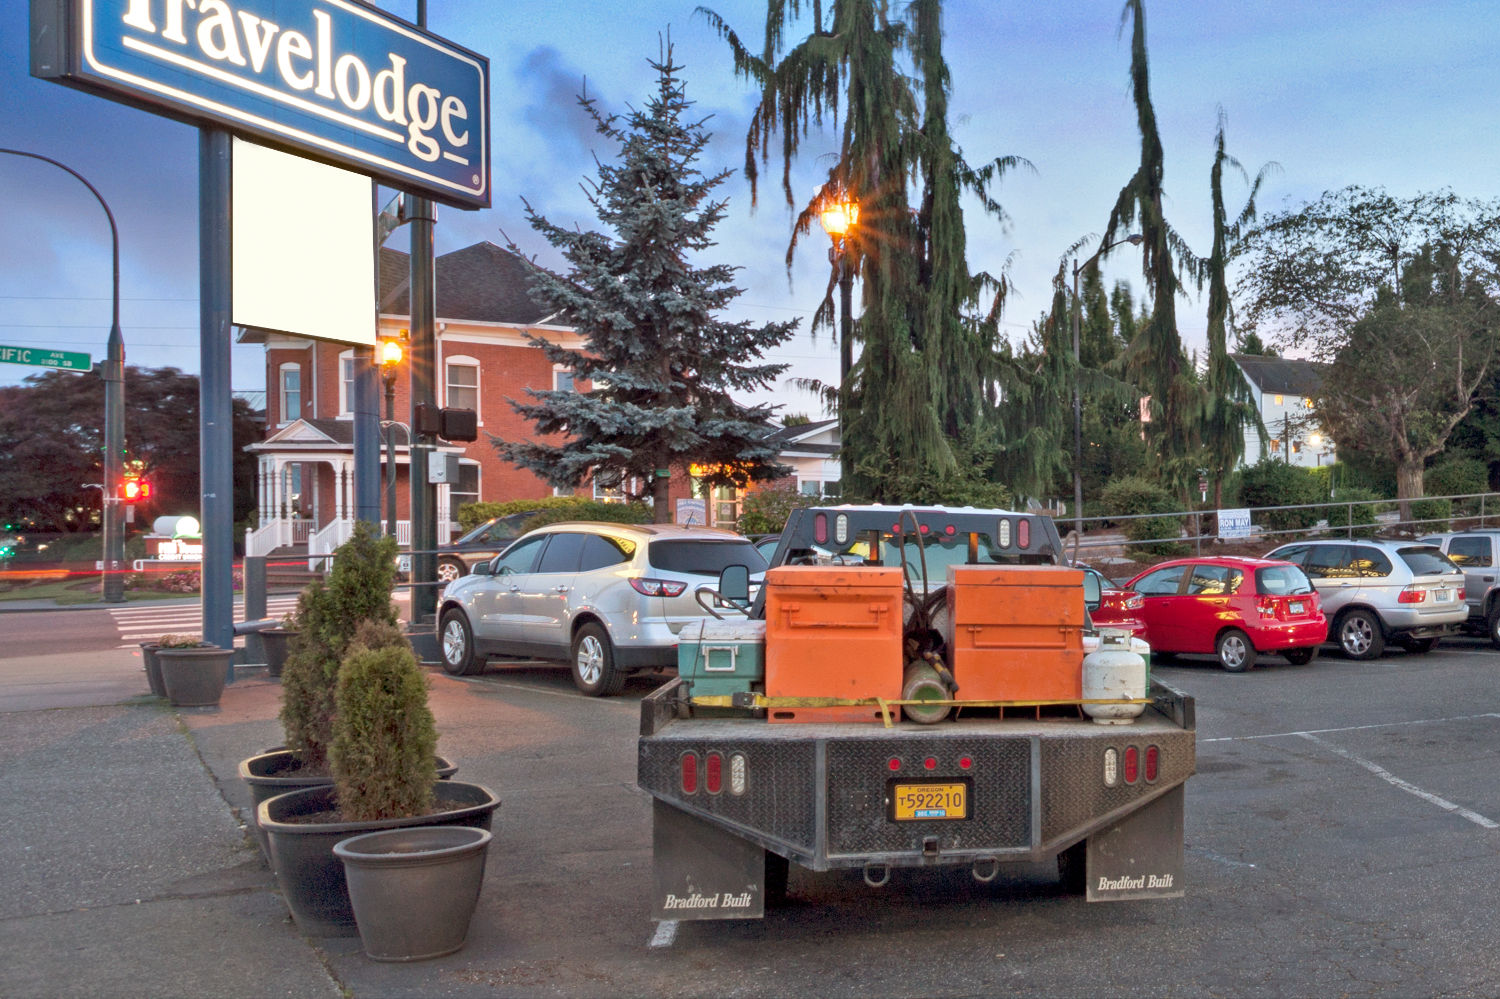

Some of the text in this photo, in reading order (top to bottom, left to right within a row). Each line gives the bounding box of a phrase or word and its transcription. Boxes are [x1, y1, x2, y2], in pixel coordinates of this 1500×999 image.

[0, 347, 31, 362] IFIC
[1220, 518, 1249, 528] RON MAY
[899, 792, 962, 809] T592210
[1097, 874, 1174, 890] Bradford Built
[663, 893, 752, 909] Bradford Built
